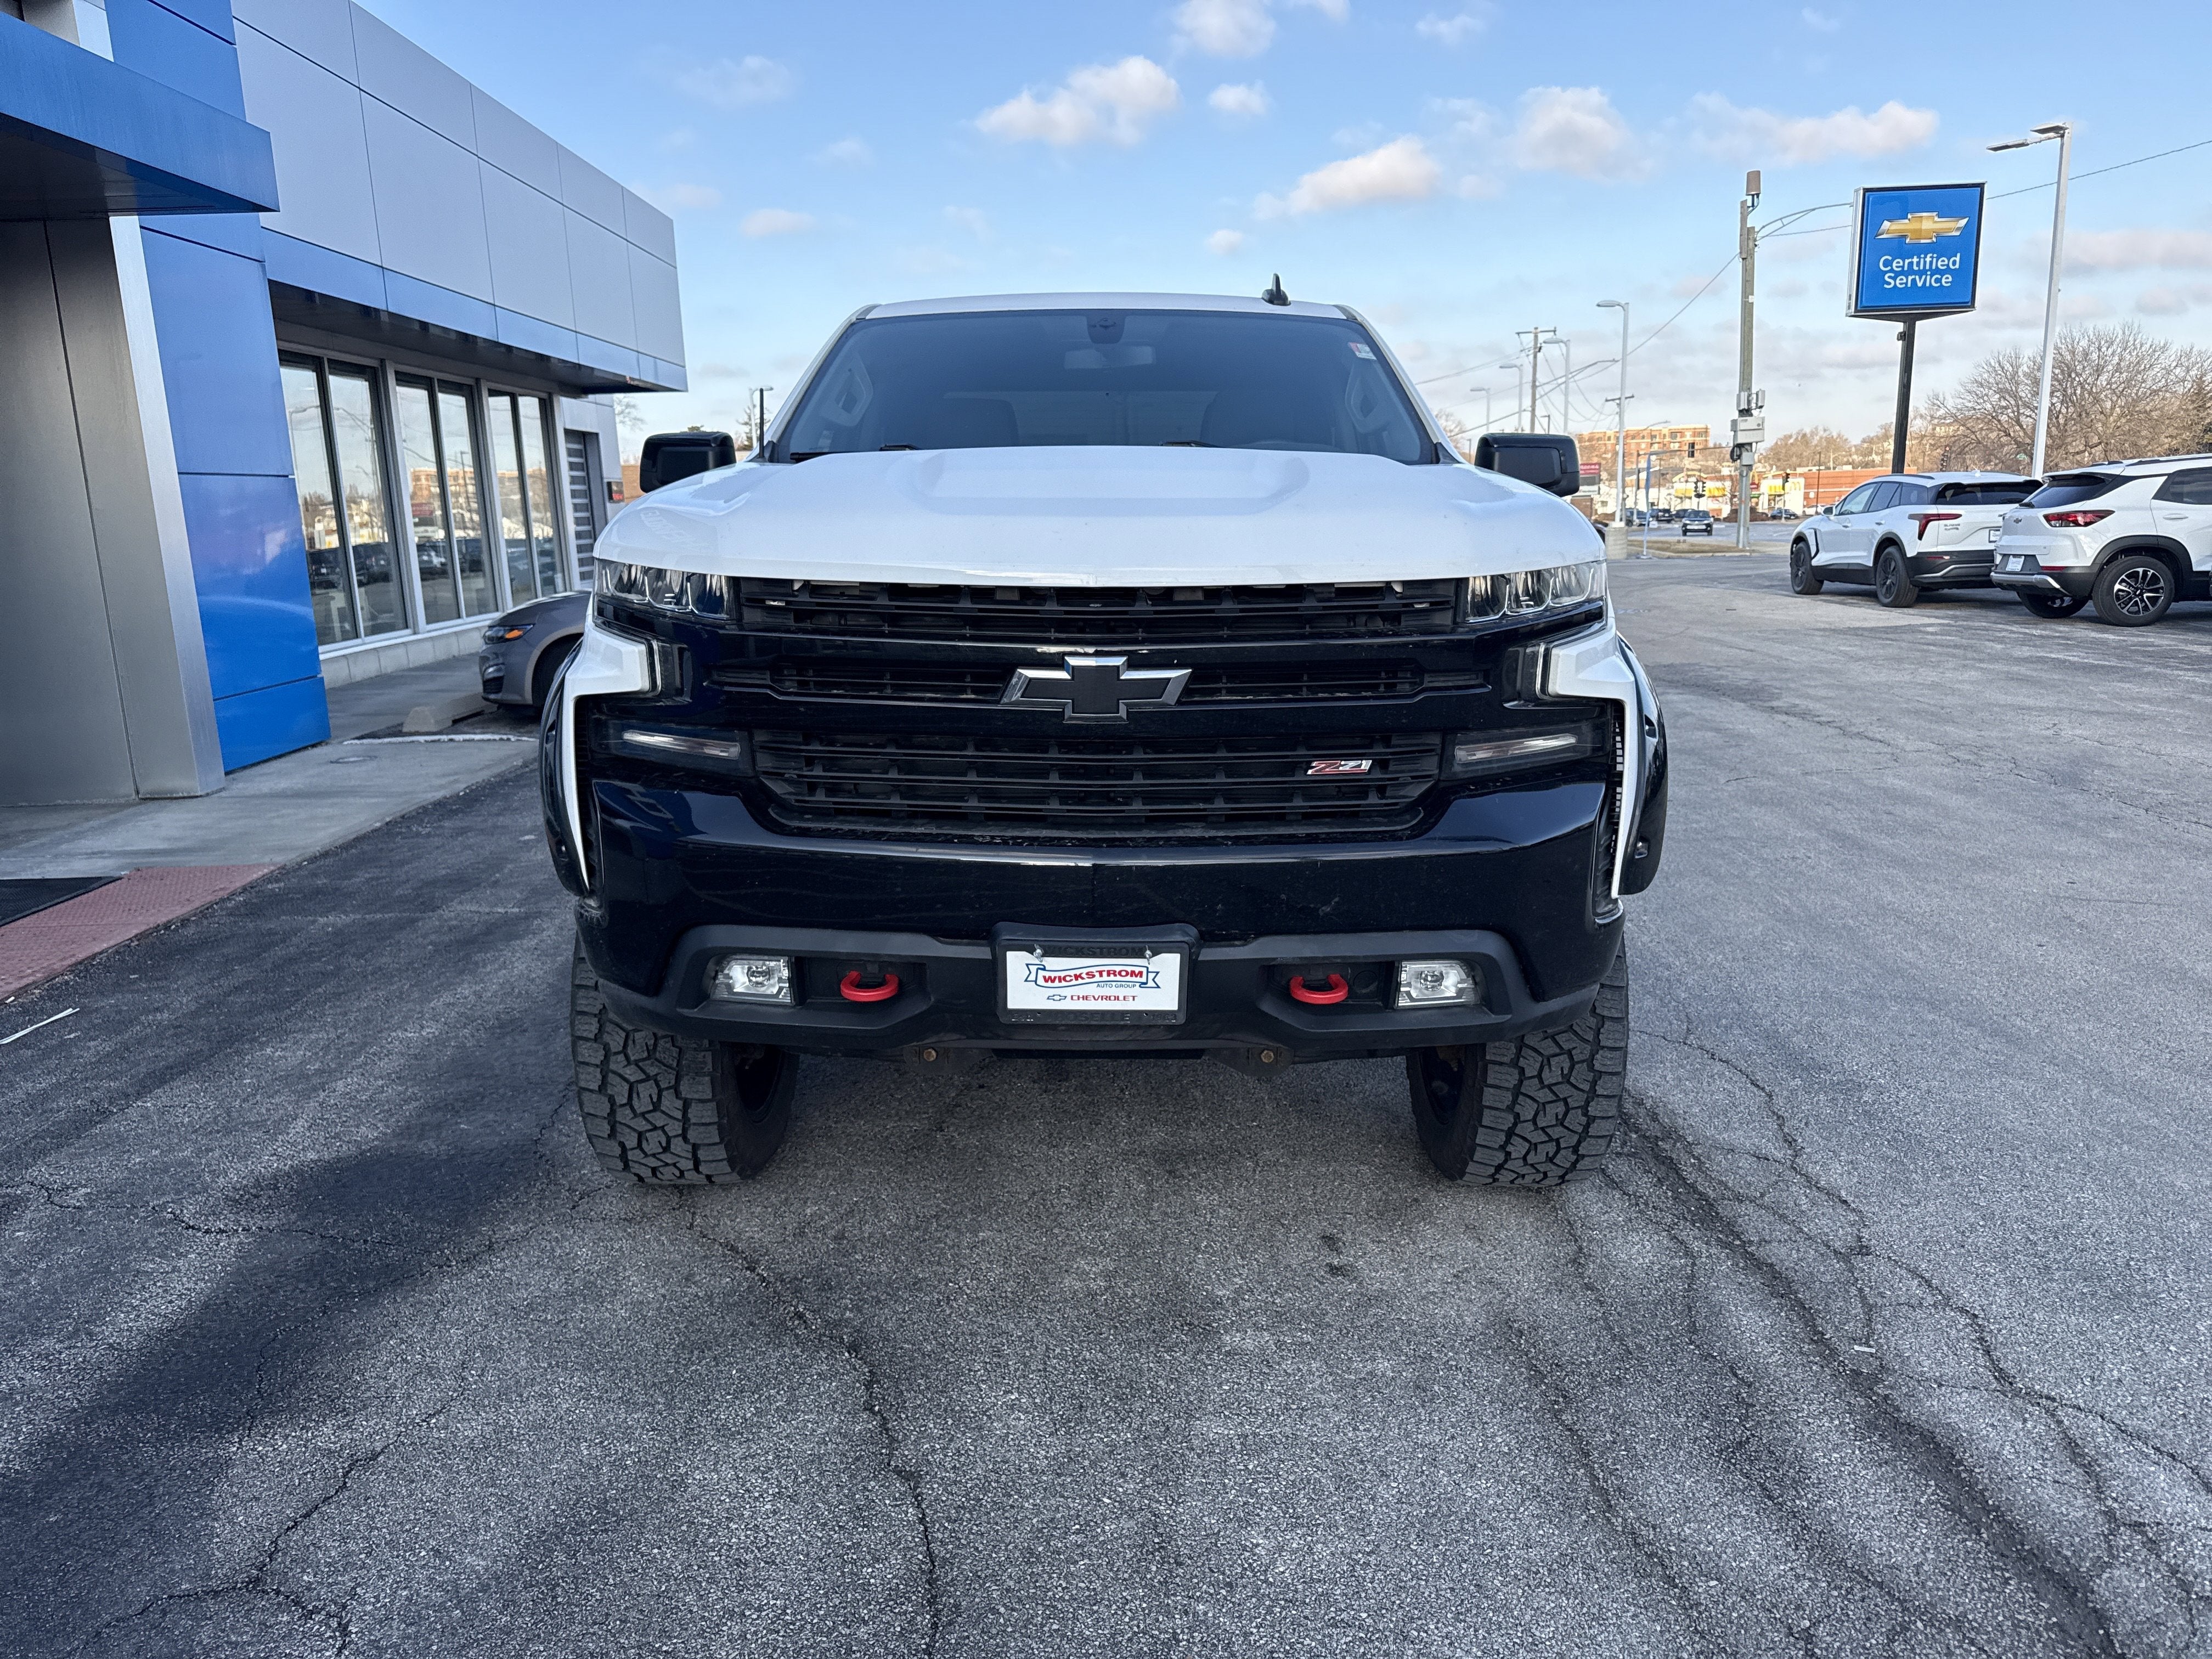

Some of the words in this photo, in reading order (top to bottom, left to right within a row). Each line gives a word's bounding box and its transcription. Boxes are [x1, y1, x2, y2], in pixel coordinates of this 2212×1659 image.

[1879, 253, 1961, 271] Certified
[1883, 271, 1953, 288] Service
[1307, 760, 1372, 775] Z71
[1042, 969, 1144, 984] WICKSTROM
